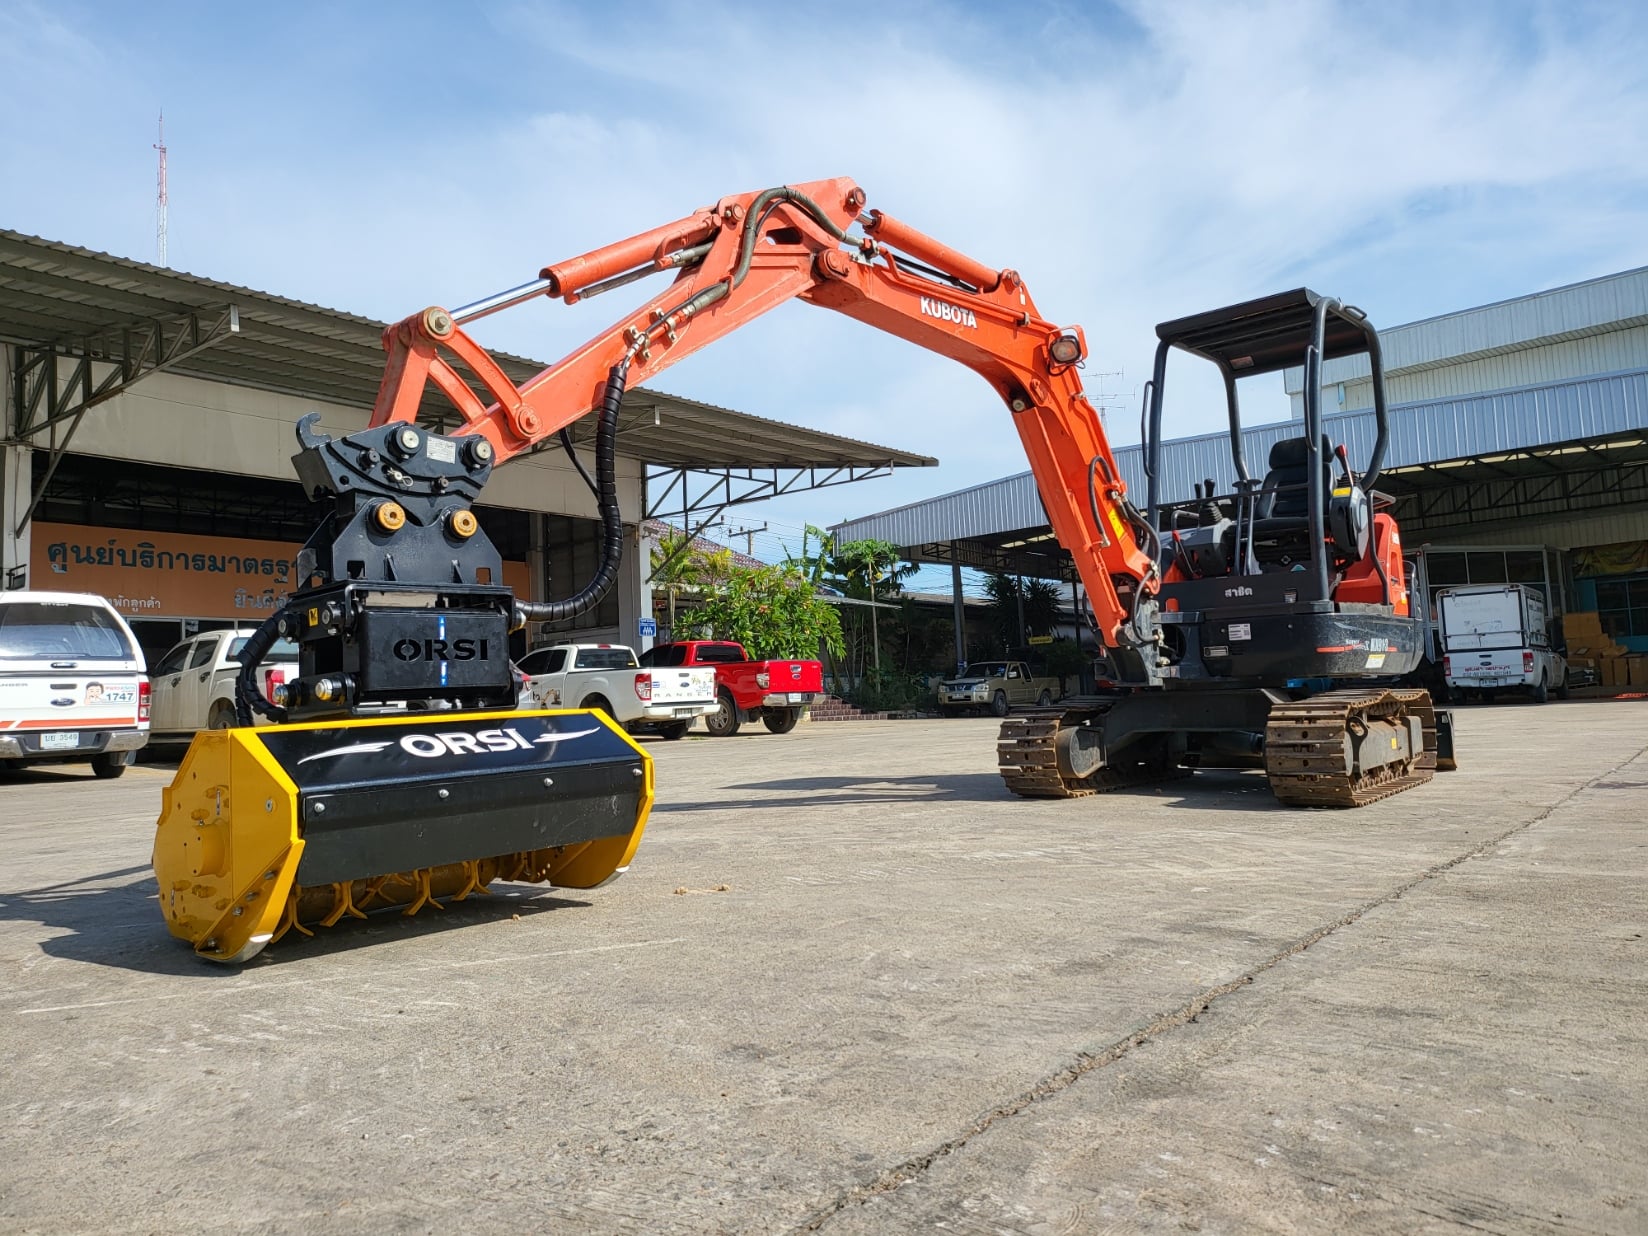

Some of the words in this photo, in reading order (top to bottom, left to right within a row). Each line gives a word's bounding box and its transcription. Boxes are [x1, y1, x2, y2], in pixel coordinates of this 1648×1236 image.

[920, 296, 978, 329] KUBOTA
[47, 539, 298, 584] ศูนย์บริการมาตรฐ
[393, 639, 489, 661] ORSI
[106, 692, 134, 701] 1747
[399, 728, 536, 758] ORSI
